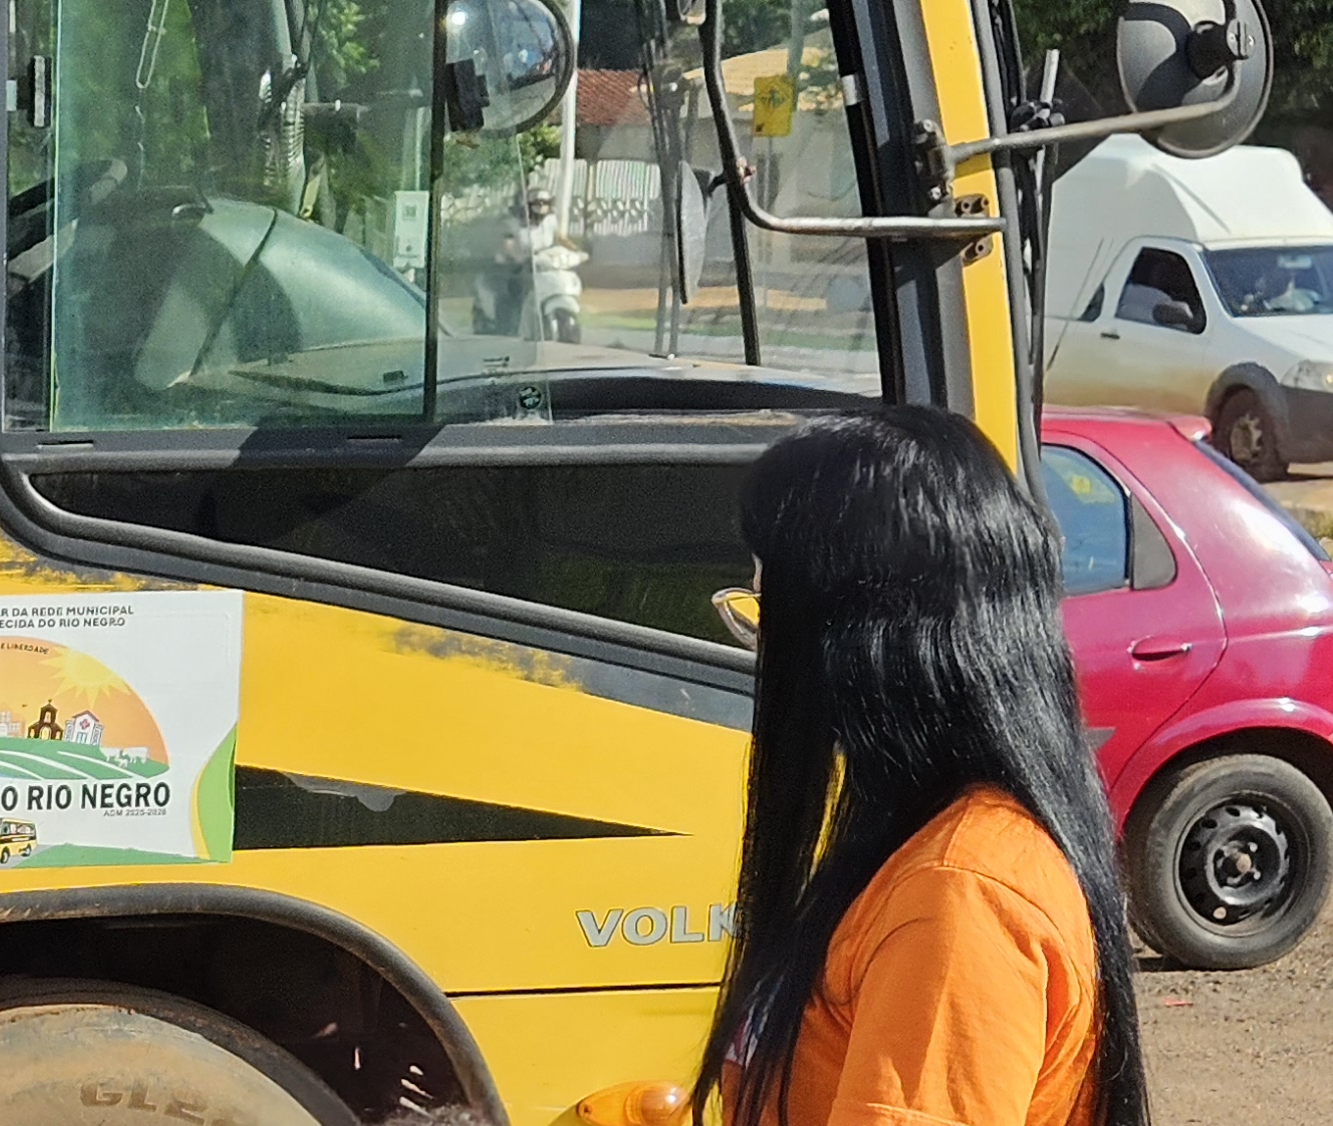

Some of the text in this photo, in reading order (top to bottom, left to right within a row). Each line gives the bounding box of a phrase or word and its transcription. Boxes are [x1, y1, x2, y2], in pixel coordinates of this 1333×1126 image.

[11, 607, 28, 617] DA
[31, 606, 63, 617] REDE
[66, 605, 134, 616] MUNICIPAL
[38, 618, 55, 628] DO
[59, 618, 80, 628] RIO
[83, 617, 126, 627] NEGRO
[27, 784, 72, 811] RIO
[80, 782, 171, 810] NEGRO
[575, 900, 738, 948] VOLK
